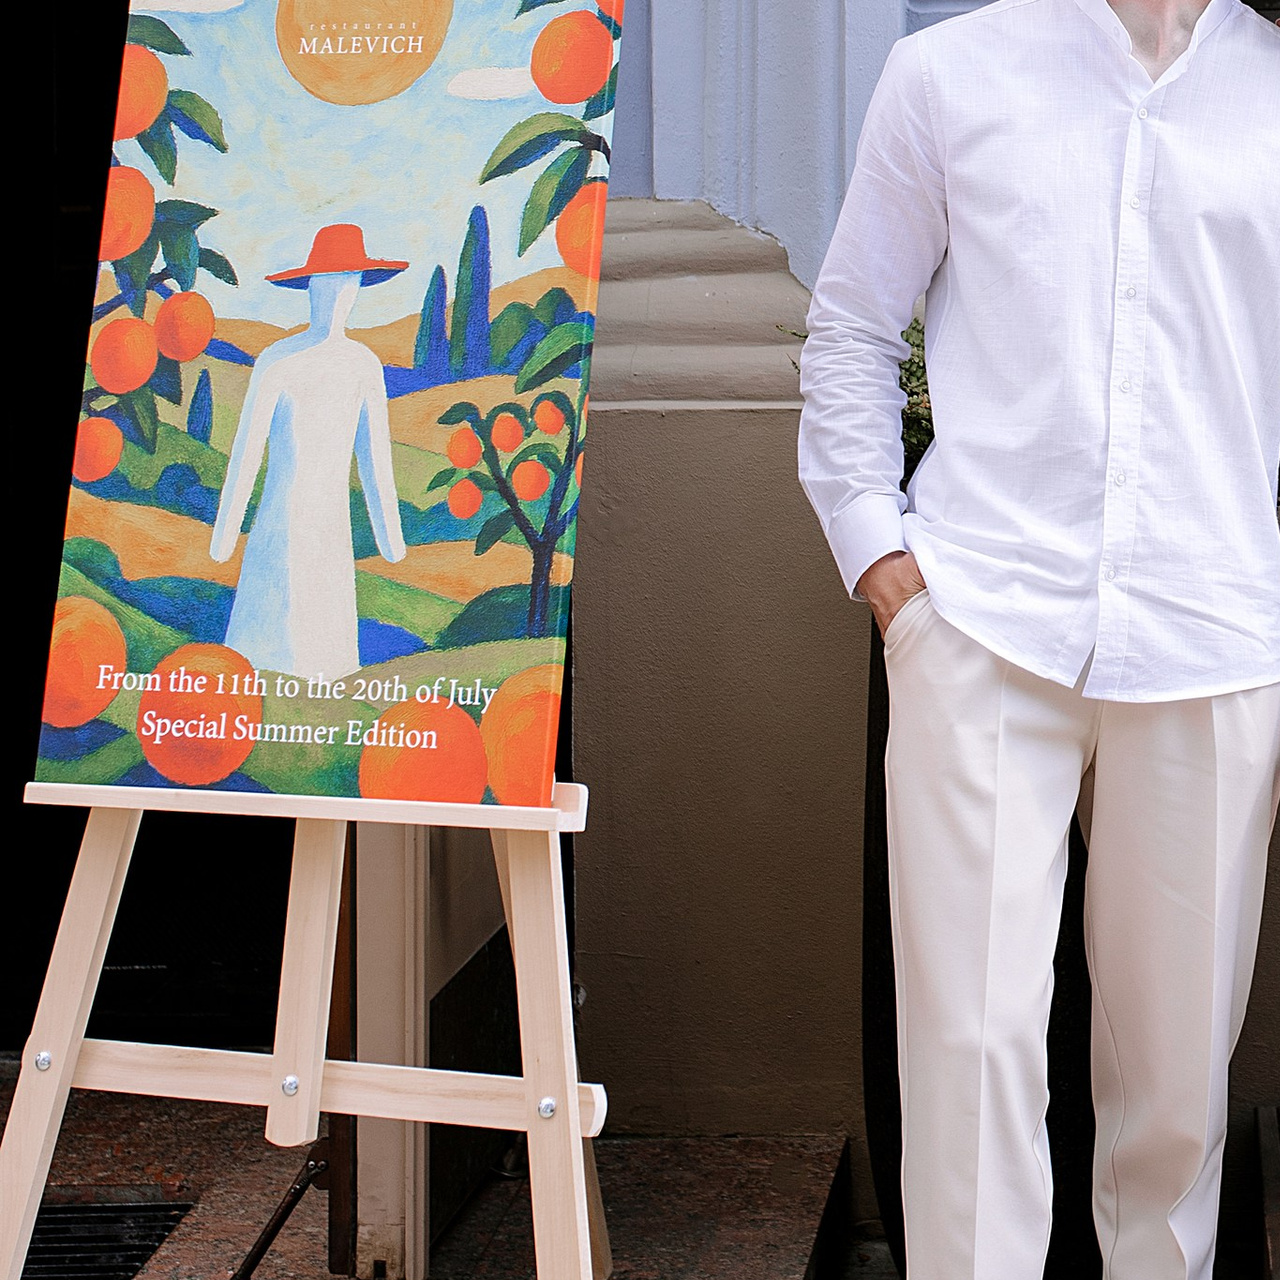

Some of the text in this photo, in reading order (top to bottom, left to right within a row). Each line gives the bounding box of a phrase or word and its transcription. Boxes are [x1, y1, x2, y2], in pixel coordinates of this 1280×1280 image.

[310, 20, 418, 31] restaurant
[299, 35, 424, 55] MALEVICH
[96, 664, 497, 714] From the 11th to the 20th of July
[141, 710, 438, 750] Special Summer Edition
